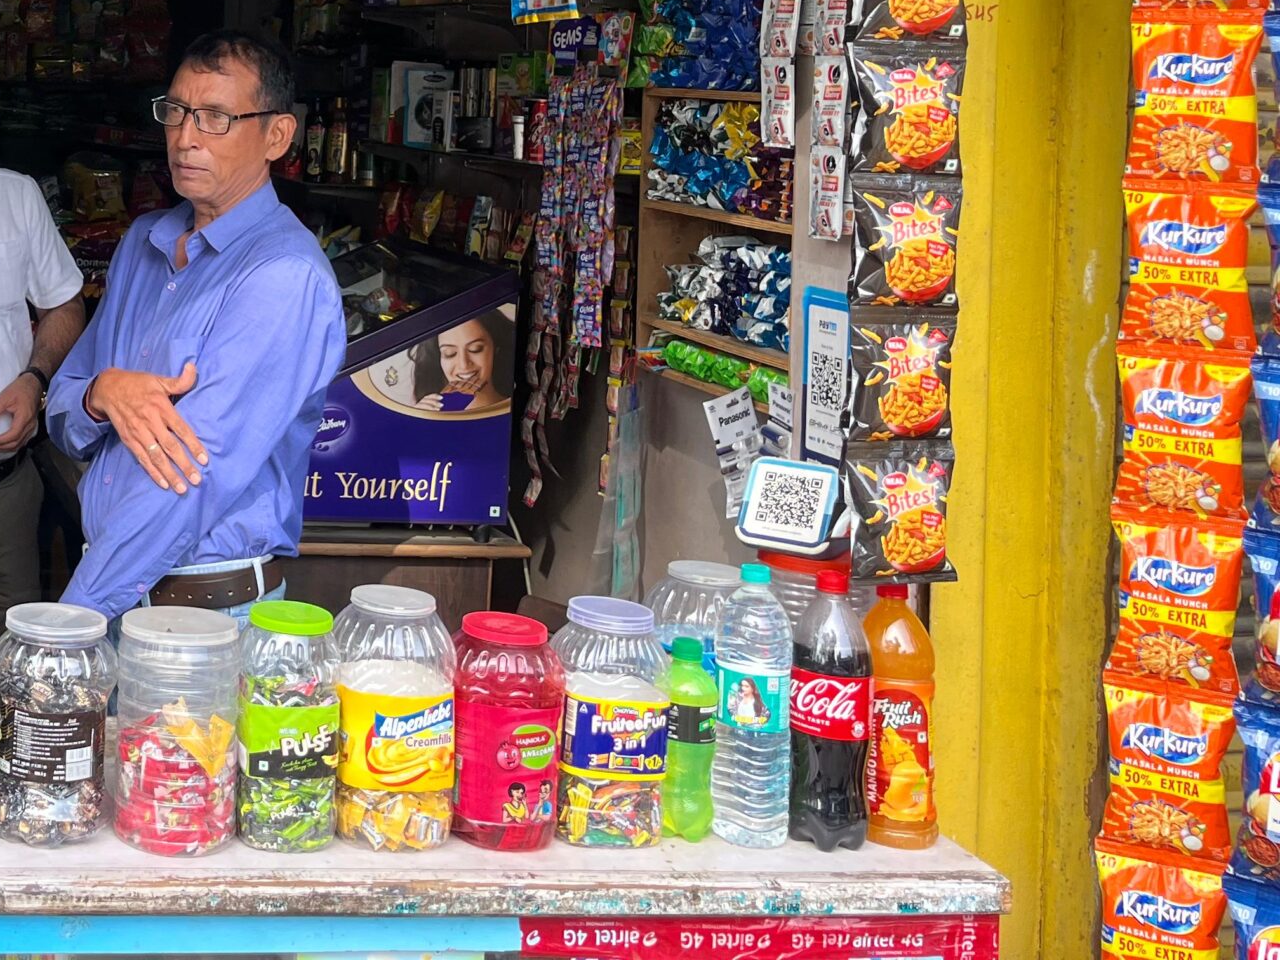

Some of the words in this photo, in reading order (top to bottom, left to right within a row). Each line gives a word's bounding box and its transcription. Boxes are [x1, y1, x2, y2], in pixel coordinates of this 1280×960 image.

[553, 27, 582, 48] GEMS
[1157, 55, 1232, 81] Kurkure
[895, 85, 943, 106] Bites!
[1193, 88, 1226, 96] MUNCH
[1151, 99, 1177, 111] 50%
[1187, 100, 1225, 115] EXTRA
[893, 217, 941, 241] Bites!
[1147, 221, 1225, 248] Kurkure
[1144, 255, 1182, 264] MASALA
[1185, 258, 1219, 267] MUNCH
[1144, 266, 1171, 280] 50%
[1180, 271, 1219, 285] EXTRA
[890, 352, 935, 378] Bites!
[1142, 390, 1219, 419] Kurkure
[718, 406, 751, 427] Panasonic
[1138, 423, 1177, 433] MASALA
[1181, 428, 1214, 438] MUNCH
[1138, 434, 1166, 448] 50%
[1175, 440, 1214, 457] EXTRA
[336, 461, 452, 513] Yourself
[889, 491, 935, 514] Bites!
[1137, 558, 1213, 588] Kurkure
[1132, 590, 1170, 603] MASALA
[1175, 599, 1208, 609] MUNCH
[1132, 602, 1159, 617] 50%
[1168, 610, 1206, 629] EXTRA
[873, 698, 912, 714] Fruit
[380, 702, 451, 738] Alpenliebe
[592, 712, 666, 735] FruiteeFun
[807, 716, 830, 726] TASTE
[882, 711, 922, 728] Rush
[280, 724, 331, 757] PULSE
[405, 733, 452, 748] Creamfills
[613, 738, 622, 751] 3
[626, 737, 638, 749] in
[640, 735, 646, 748] 1
[1129, 723, 1206, 756] Kurkure
[1125, 757, 1162, 771] MASALA
[1167, 767, 1200, 779] MUNCH
[867, 759, 877, 802] MANGO
[1125, 769, 1152, 785] 50%
[1160, 777, 1199, 798] EXTRA
[1122, 892, 1200, 925] Kurkure
[563, 930, 587, 947] 4G
[595, 930, 640, 947] airtel
[680, 932, 704, 949] 4G
[711, 932, 755, 950] airtel
[791, 934, 814, 948] 4G
[1118, 925, 1157, 940] MASALA
[1161, 935, 1193, 948] MUNCH
[1118, 937, 1146, 952] 50%
[1155, 944, 1193, 960] EXTRA
